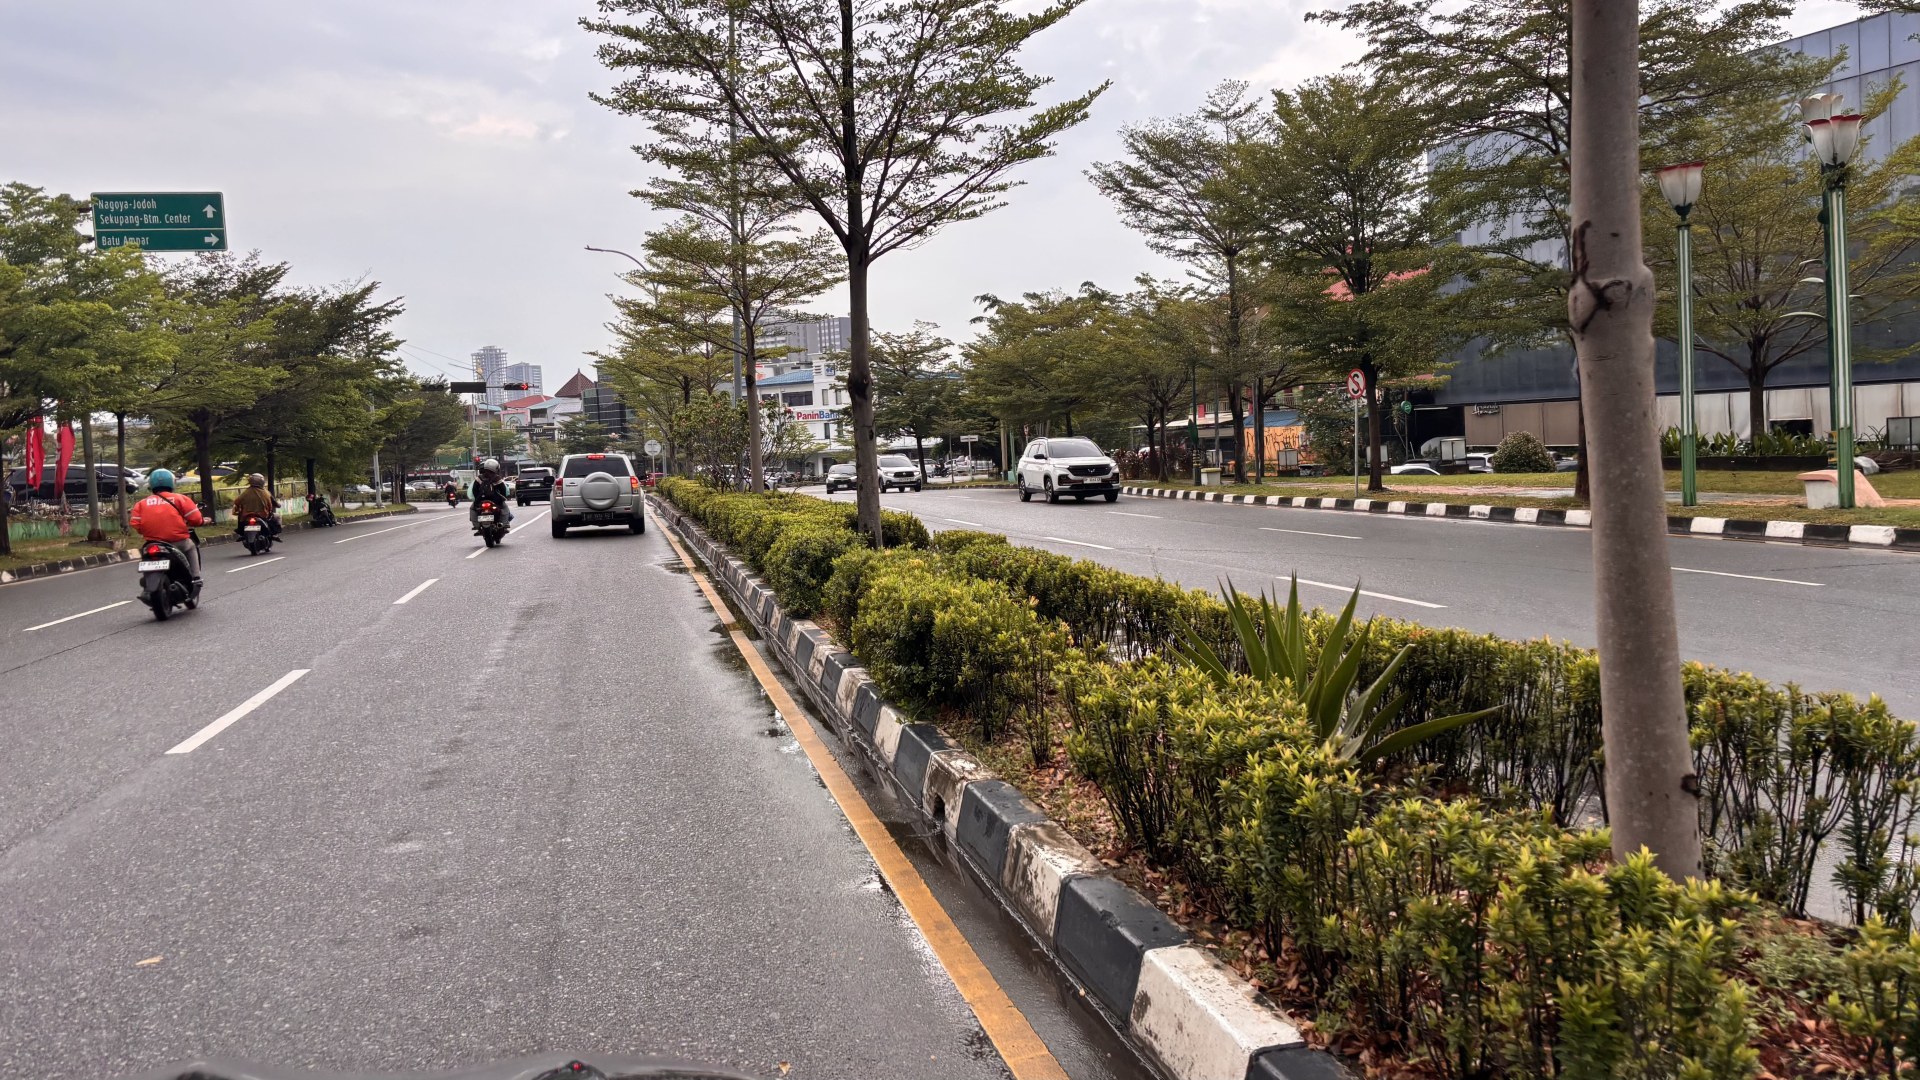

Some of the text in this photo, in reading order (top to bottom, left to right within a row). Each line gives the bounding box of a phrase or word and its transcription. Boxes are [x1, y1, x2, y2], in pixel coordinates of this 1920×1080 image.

[98, 199, 157, 212] Nagoya-Jodoh
[100, 213, 191, 226] Sekupang-Btm. Center
[101, 236, 120, 246] Batu
